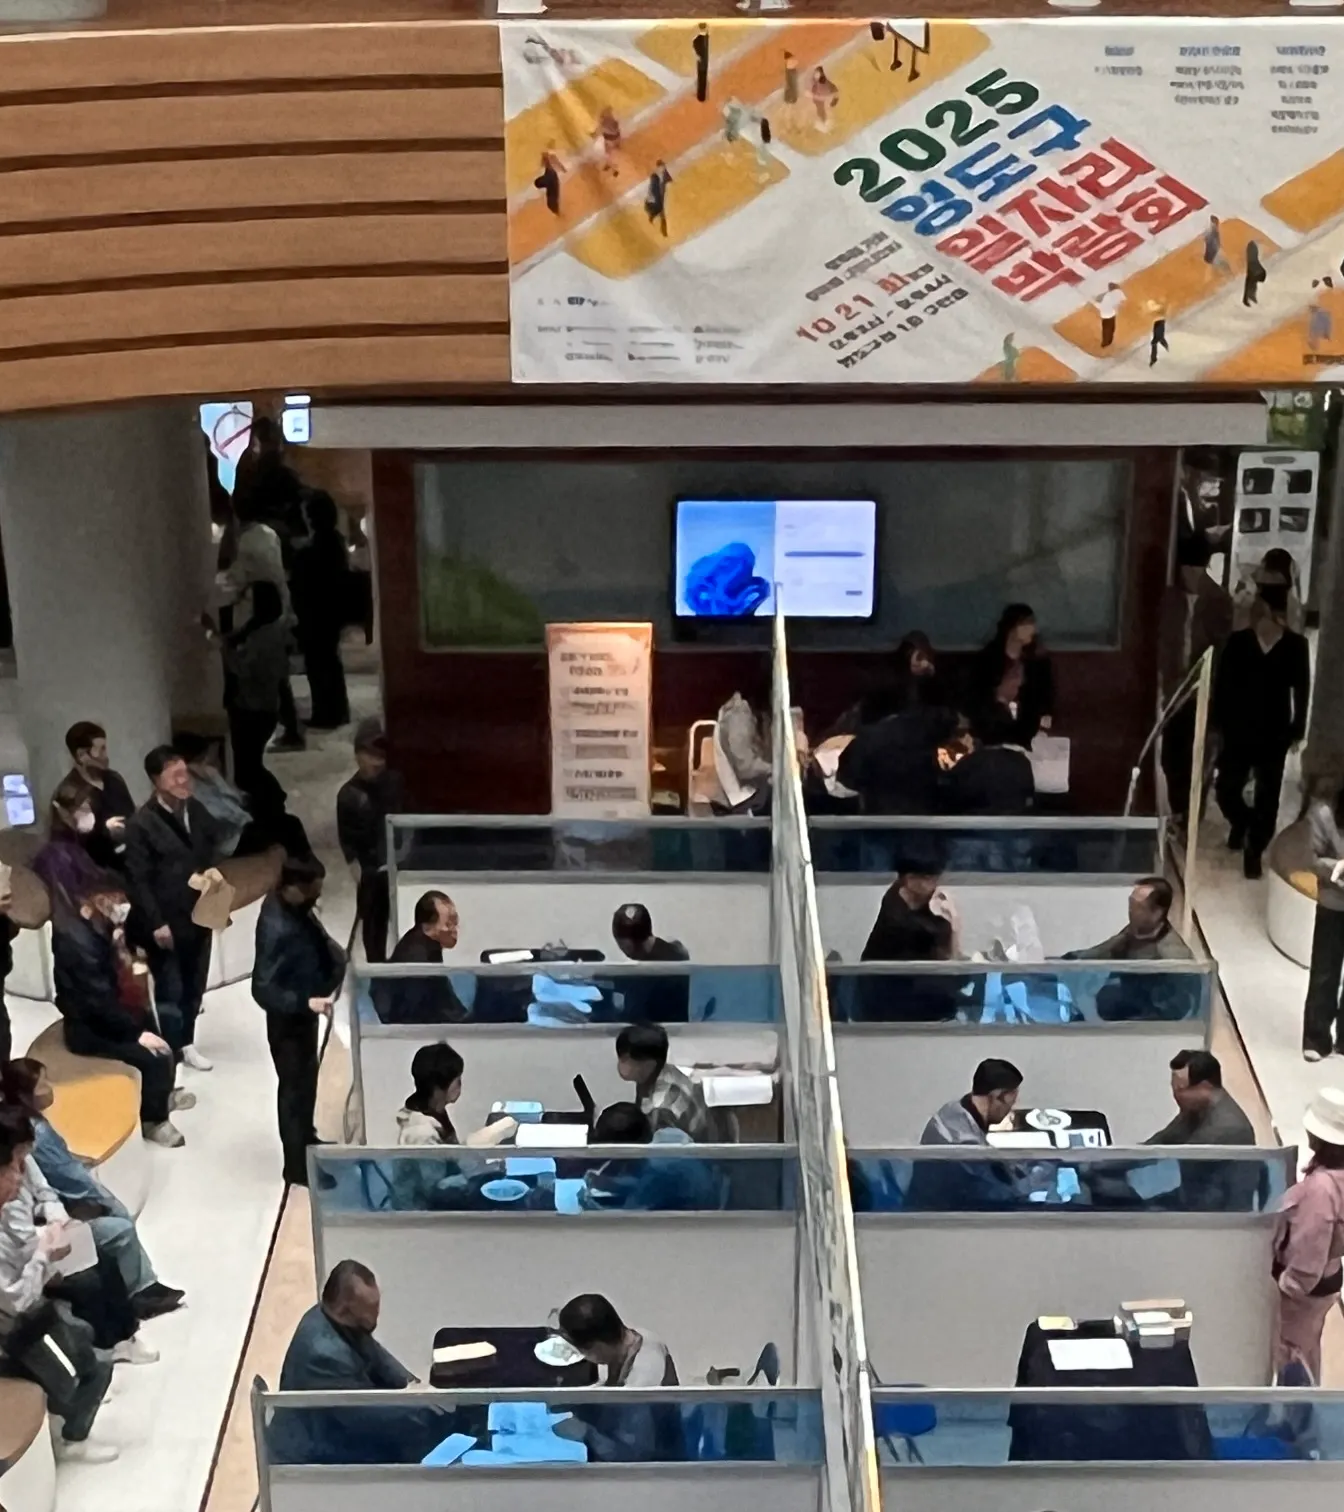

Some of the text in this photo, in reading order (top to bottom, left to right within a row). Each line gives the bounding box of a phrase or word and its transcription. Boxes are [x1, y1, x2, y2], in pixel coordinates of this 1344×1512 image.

[833, 67, 1040, 203] 2025
[879, 103, 1093, 237] 영도구
[935, 136, 1157, 275] 일자리
[991, 174, 1211, 303] 박람회
